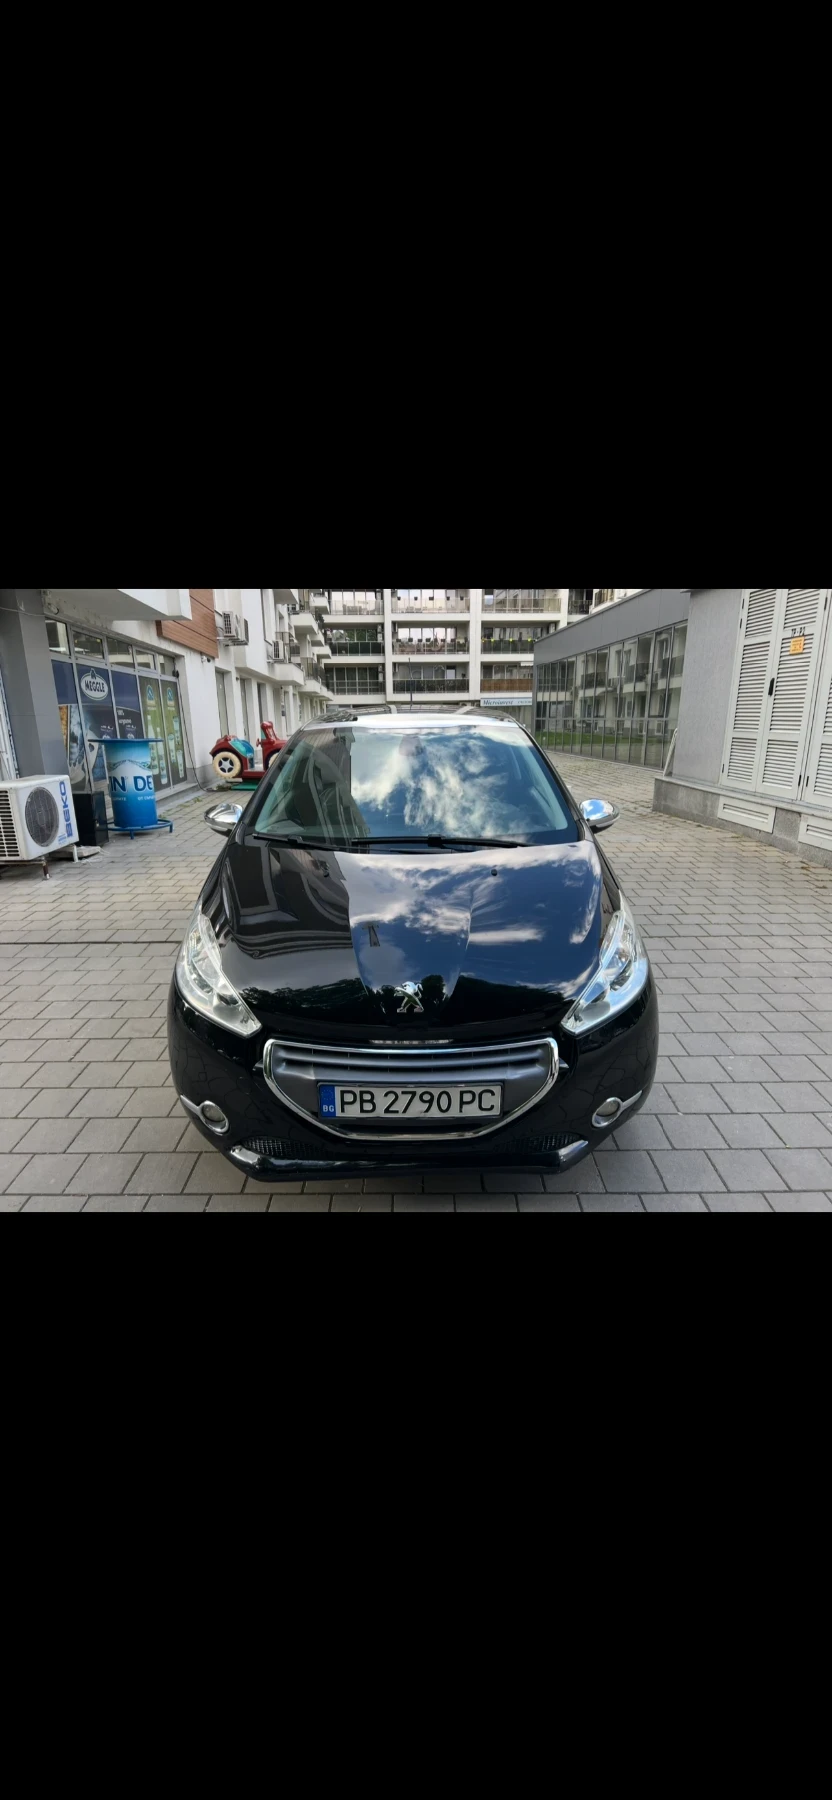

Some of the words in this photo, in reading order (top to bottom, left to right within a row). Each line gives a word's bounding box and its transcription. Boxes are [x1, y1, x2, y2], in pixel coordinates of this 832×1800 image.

[84, 680, 105, 693] MEGGLE
[59, 781, 73, 837] BEKO
[322, 1104, 335, 1113] BG
[340, 1090, 376, 1113] PB
[383, 1090, 452, 1114] 2790
[459, 1089, 496, 1113] PC
